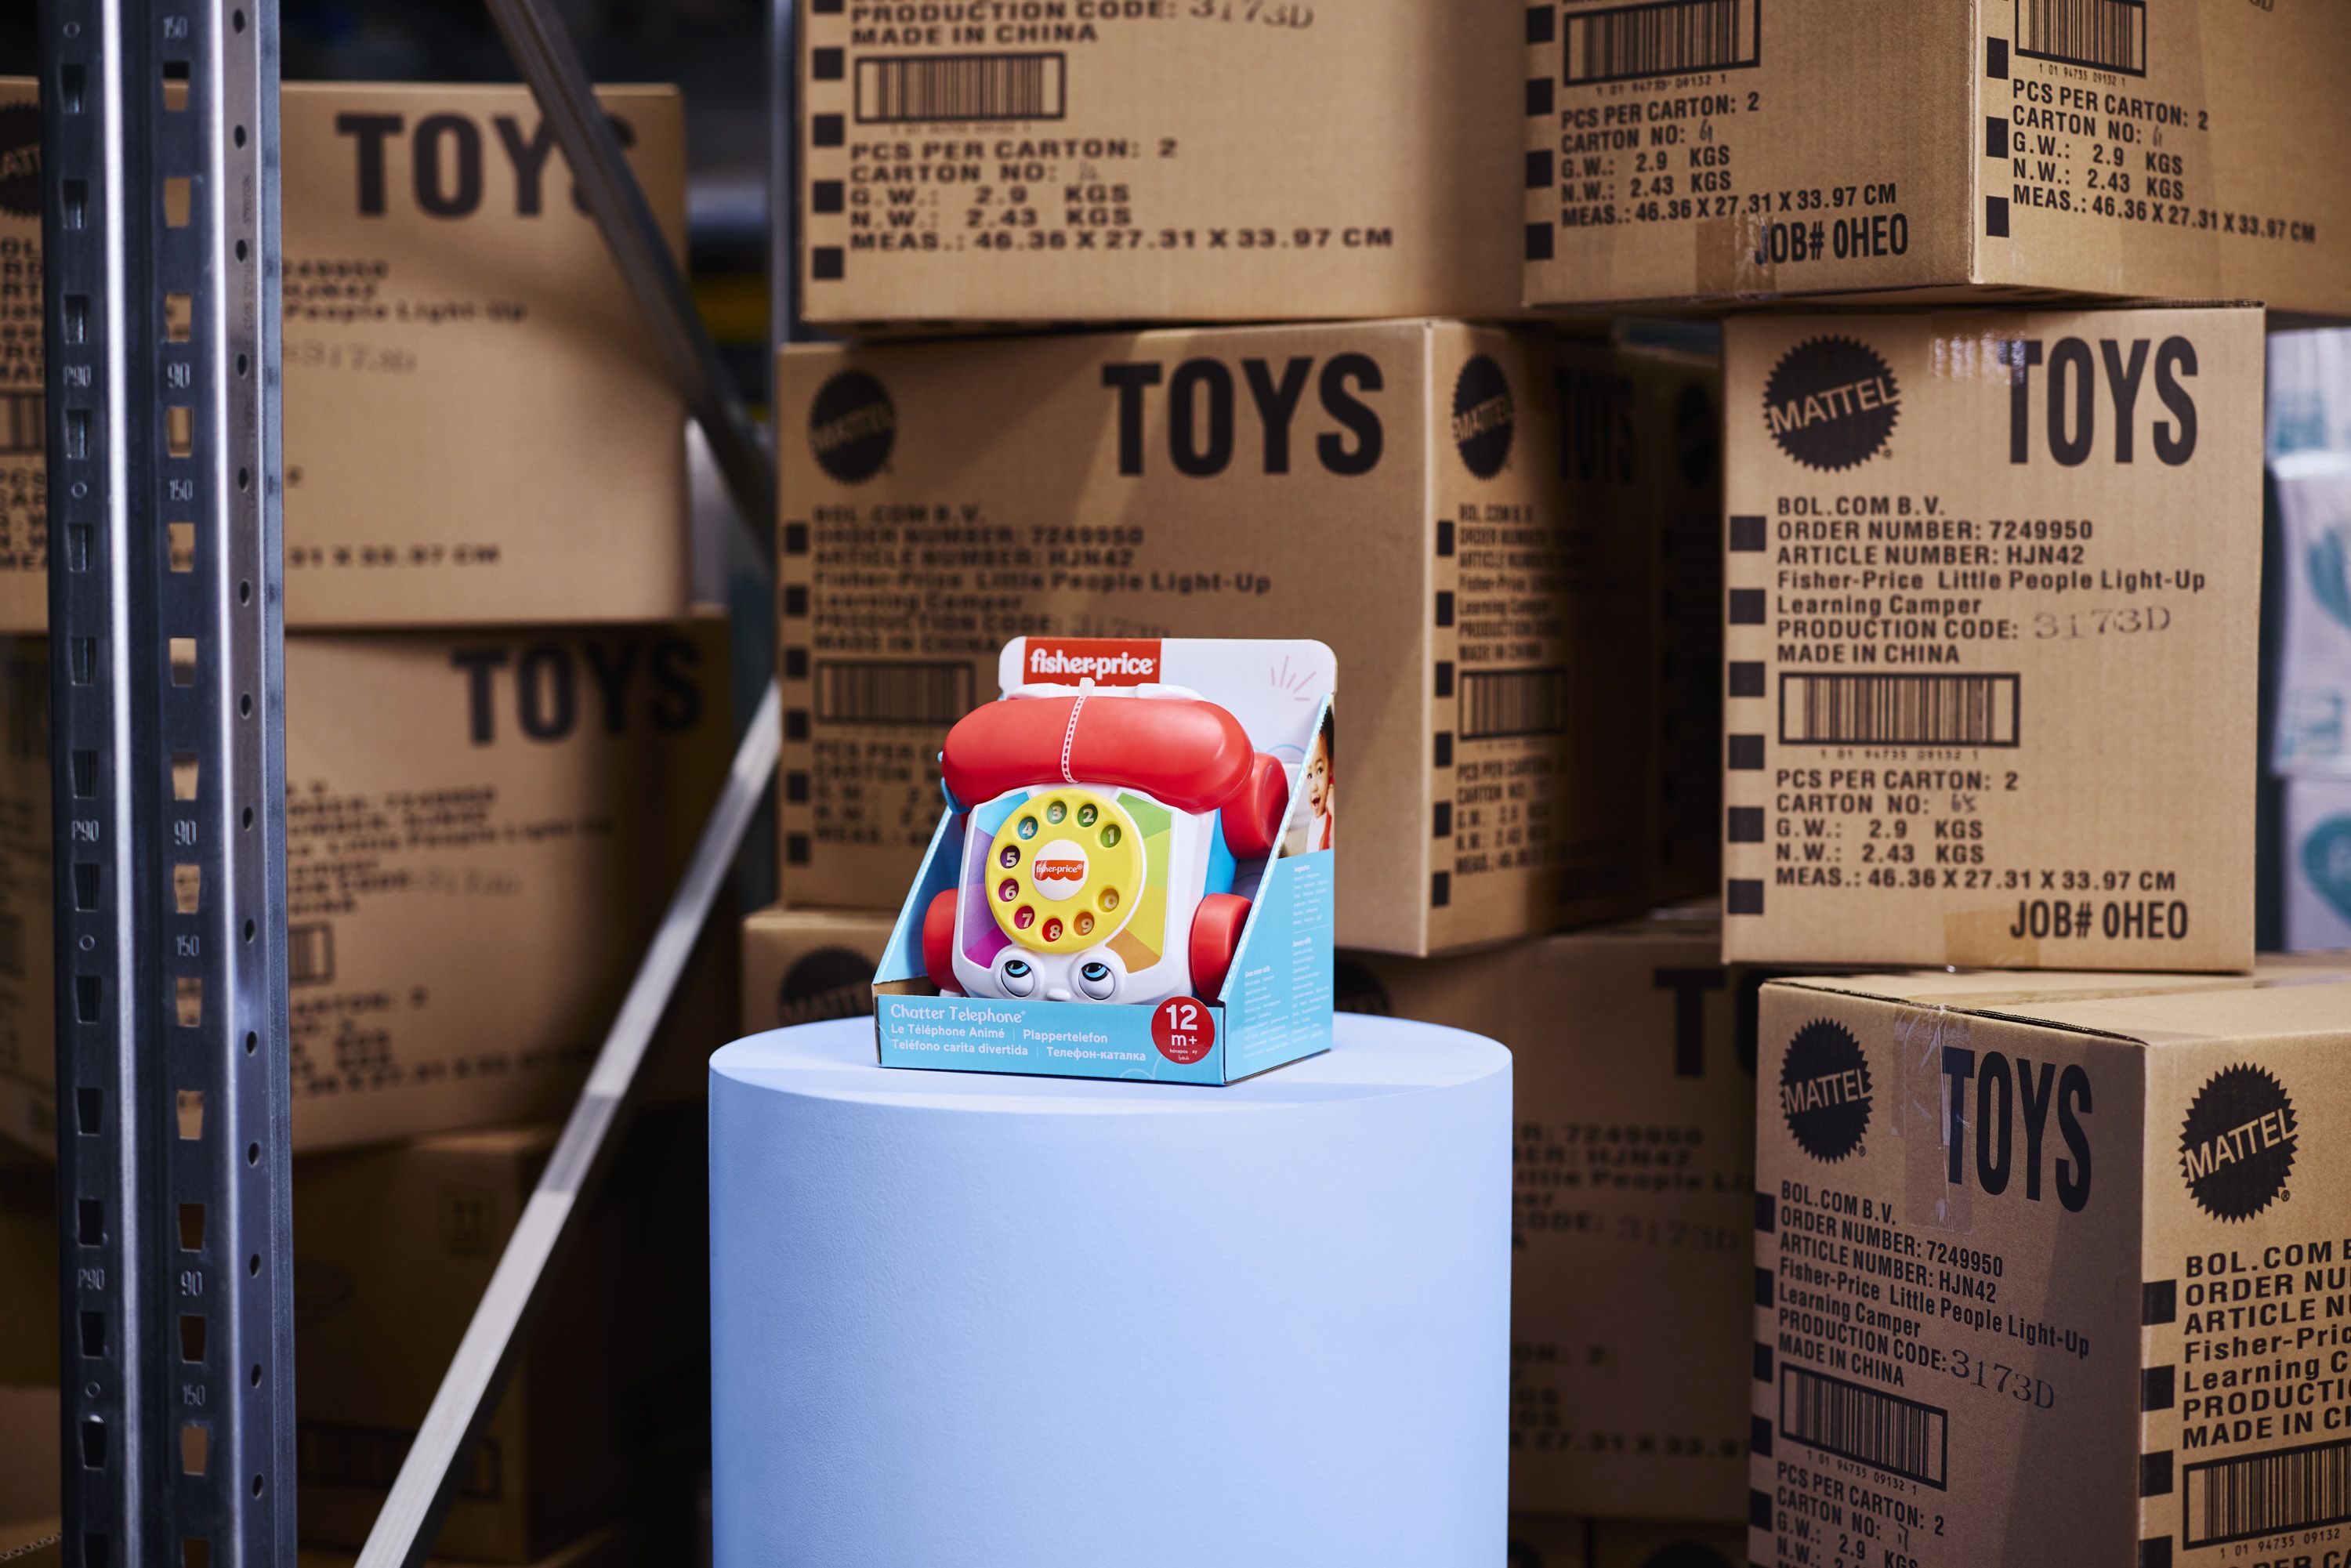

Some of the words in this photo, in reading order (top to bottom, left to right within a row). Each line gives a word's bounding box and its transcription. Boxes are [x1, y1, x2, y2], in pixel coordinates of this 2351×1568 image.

[1561, 107, 1599, 131] PCS
[1604, 103, 1641, 127] PER
[1647, 93, 1737, 121] CARTON:
[1748, 91, 1759, 111] 2
[2013, 78, 2052, 104] PCS
[2060, 86, 2098, 112] PER
[2105, 94, 2188, 128] CARTON:
[2198, 109, 2208, 131] 2
[2013, 104, 2096, 137] CARTON
[2108, 120, 2142, 144] NO:
[1561, 204, 1631, 228] MEAS.:
[1636, 199, 1691, 223] 46.36
[1715, 193, 1770, 217] 27.31
[1798, 186, 1857, 211] 33.97
[1864, 183, 1896, 206] CM
[167, 363, 190, 389] 90
[1770, 378, 1901, 433] MATTEL
[1997, 335, 2198, 466] TOYS
[1102, 352, 1384, 477] TOYS
[1778, 496, 1889, 516] BOL.COM
[1898, 496, 1944, 516] B.V.
[1778, 520, 1859, 540] ORDER
[1868, 520, 1981, 541] NUMBER:
[1990, 520, 2092, 541] 7249950
[1777, 545, 1876, 565] ARTICLE
[1886, 545, 1998, 565] NUMBER:
[2007, 545, 2084, 565] HJN42
[1778, 570, 1923, 590] Fisher-Price
[1939, 570, 2001, 590] Little
[2009, 570, 2092, 593] People
[2101, 570, 2204, 593] Light-Up
[1777, 595, 1882, 620] Learning
[1889, 595, 1981, 618] Camper
[1777, 618, 1936, 639] PRODUCTION
[1944, 619, 2018, 639] CODE:
[1777, 644, 1844, 663] MADE
[1853, 644, 1876, 663] IN
[1885, 644, 1959, 663] CHINA
[451, 636, 703, 747] TOYS
[1777, 769, 1821, 789] PCS
[1830, 769, 1875, 790] PER
[1884, 770, 1991, 791] CARTON:
[2005, 770, 2018, 791] 2
[1052, 806, 1062, 820] 3
[1082, 809, 1094, 823] 2
[1777, 793, 1872, 813] CARTON
[1888, 794, 1929, 815] NO:
[174, 820, 197, 846] 90
[1022, 821, 1034, 836] 4
[1108, 829, 1114, 843] 1
[1777, 818, 1842, 838] G.W.:
[1869, 819, 1907, 839] 2.9
[1935, 819, 1983, 840] KGS
[1005, 852, 1016, 867] 5
[1777, 842, 1842, 862] N.W.:
[1862, 843, 1914, 864] 2.43
[1936, 844, 1983, 864] KGS
[1005, 885, 1016, 899] 6
[1777, 866, 1860, 887] MEAS.:
[1868, 867, 1936, 889] 46.36
[1943, 868, 1957, 888] X
[1965, 868, 2030, 889] 27.31
[2041, 871, 2054, 890] X
[2063, 870, 2130, 891] 33.97
[2139, 871, 2175, 892] CM
[1022, 913, 1032, 927] 7
[1049, 925, 1061, 940] 8
[1081, 918, 1093, 932] 9
[2009, 900, 2092, 940] JOB#
[890, 1004, 945, 1019] Chatter
[949, 1005, 1023, 1025] Telephone
[1165, 1004, 1198, 1030] 12
[891, 1023, 904, 1034] Le
[907, 1023, 965, 1037] Téléphone
[969, 1027, 1005, 1038] Animé
[1023, 1029, 1108, 1043] Plappertelefon
[892, 1038, 940, 1051] Teléfono
[944, 1042, 975, 1053] carita
[978, 1043, 1028, 1056] divertida
[1046, 1046, 1147, 1061] Телефон-каталка
[1783, 1068, 1875, 1115] MATTEL
[1942, 1045, 2093, 1212] TOYS
[2185, 1108, 2299, 1182] MATTEL
[1781, 1179, 1857, 1216] BOL.COM
[1863, 1198, 1896, 1226] B.V.
[1781, 1204, 1836, 1237] ORDER
[1842, 1220, 1922, 1258] NUMBER:
[1927, 1240, 2002, 1278] 7249950
[1780, 1230, 1848, 1266] ARTICLE
[1853, 1248, 1933, 1288] NUMBER:
[1940, 1269, 1996, 1305] HJN42
[2186, 1240, 2331, 1278] BOL.COM
[180, 1270, 204, 1297] 90
[2186, 1273, 2293, 1306] ORDER
[1780, 1255, 1879, 1301] Fisher-Price
[1890, 1284, 1934, 1316] Little
[1940, 1297, 2001, 1333] People
[2009, 1314, 2089, 1357] Light-Up
[1780, 1281, 1850, 1324] Learning
[1856, 1302, 1921, 1338] Camper
[2184, 1298, 2315, 1335] ARTICLE
[1779, 1306, 1888, 1356] PRODUCTION
[1894, 1338, 1947, 1373] CODE:
[1779, 1332, 1824, 1363] MADE
[1830, 1346, 1846, 1370] IN
[1852, 1353, 1904, 1387] CHINA
[1951, 1349, 2055, 1409] 3173D
[2184, 1358, 2319, 1392] Learning
[2183, 1416, 2272, 1450] MADE
[2283, 1410, 2312, 1436] IN
[1777, 1460, 1808, 1489] PCS
[1813, 1472, 1844, 1502] PER
[1849, 1485, 1925, 1530] CARTON:
[1935, 1515, 1943, 1537] 2
[2235, 1544, 2248, 1557] 01
[2259, 1535, 2295, 1552] 94735
[2304, 1527, 2340, 1544] 09132
